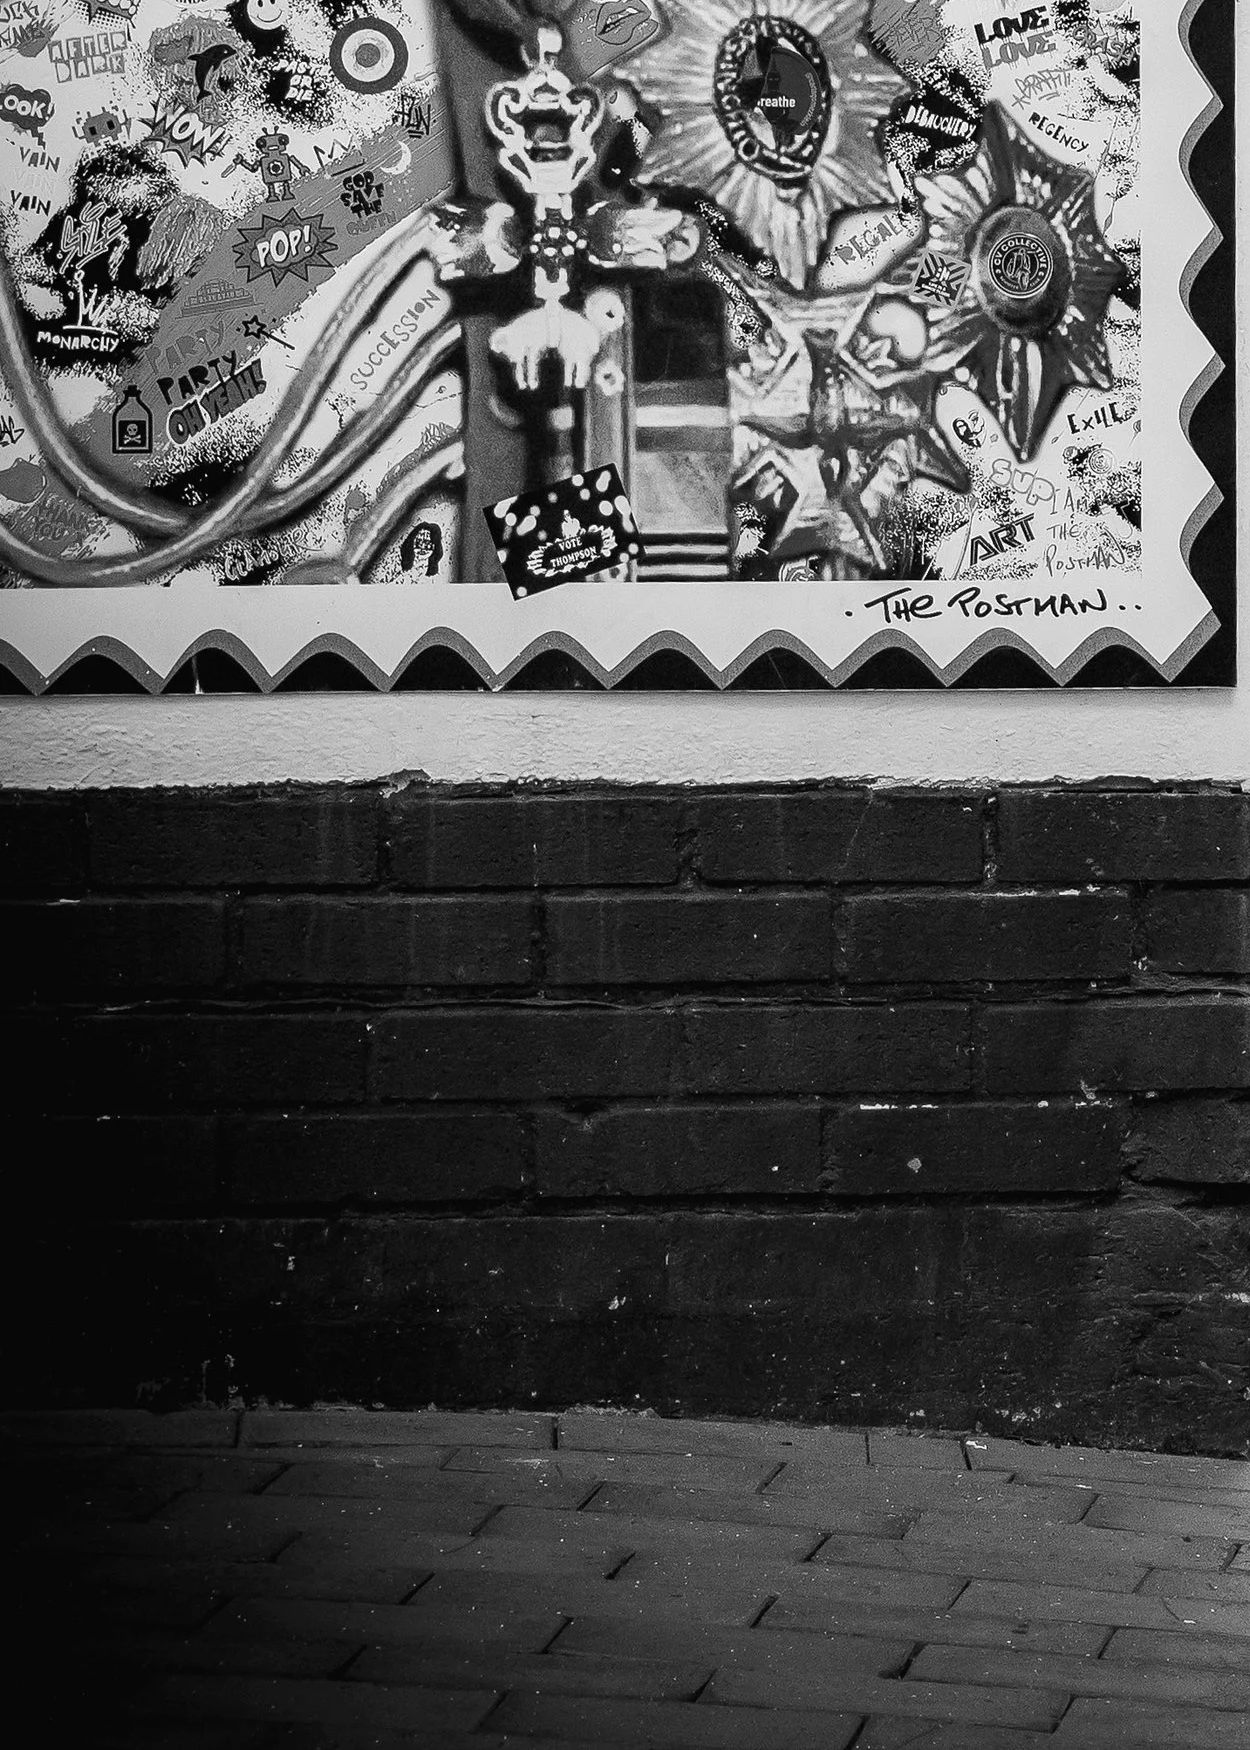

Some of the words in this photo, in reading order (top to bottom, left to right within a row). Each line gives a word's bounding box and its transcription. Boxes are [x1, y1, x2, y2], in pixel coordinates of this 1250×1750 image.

[974, 5, 1050, 46] LOVE
[48, 30, 128, 63] AFTER
[982, 30, 1057, 70] LOVE
[55, 52, 126, 84] DARK
[0, 94, 54, 121] OOK!
[905, 105, 977, 139] DEBAUCHERY
[155, 98, 233, 161] WOW!
[1028, 111, 1090, 153] REGENCY
[19, 146, 61, 173] VAIN
[342, 170, 375, 191] GOD
[10, 190, 52, 217] VAIN
[256, 224, 313, 269] POP!
[1001, 238, 1048, 269] COLLECTIVE
[36, 331, 119, 353] MONARCHY
[350, 289, 441, 391] SUCCESSION
[156, 350, 237, 406] PARTY
[168, 399, 207, 445] OH
[549, 545, 598, 568] THOMPSON
[558, 536, 582, 551] VOTE
[970, 513, 1035, 567] ART
